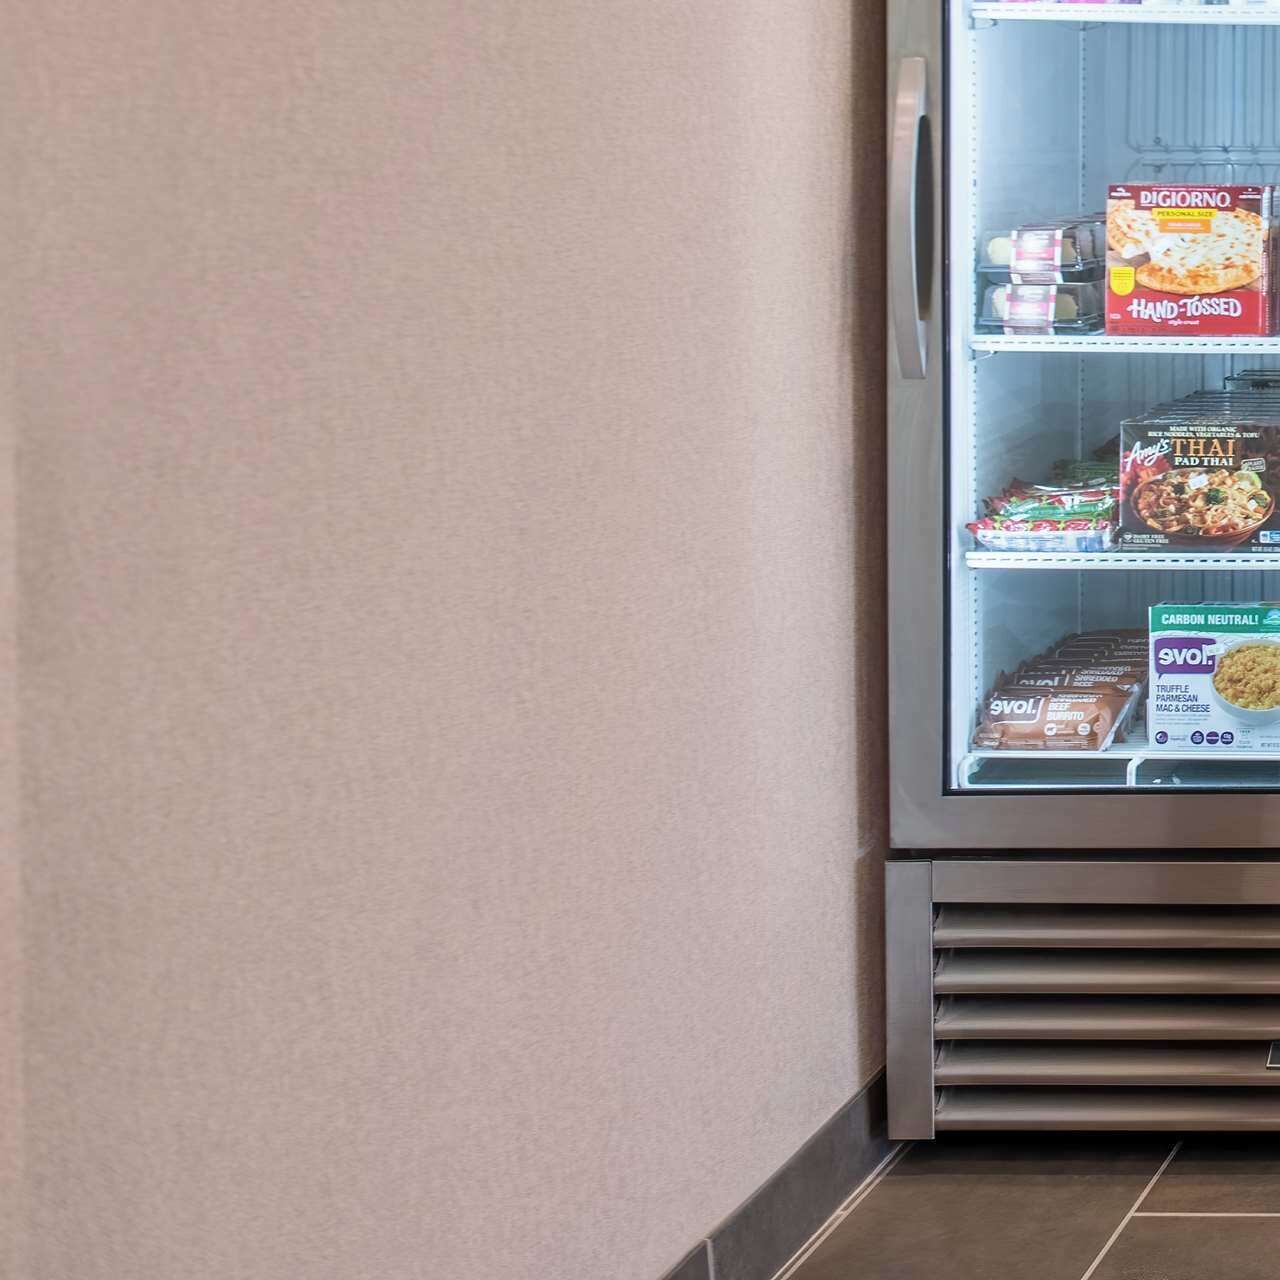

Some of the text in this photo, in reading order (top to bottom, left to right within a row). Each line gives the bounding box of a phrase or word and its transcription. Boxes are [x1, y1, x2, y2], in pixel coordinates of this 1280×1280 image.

[1126, 296, 1241, 323] HAND-TOSSED
[1171, 439, 1235, 456] THAI
[1122, 438, 1172, 471] Amy's
[1174, 457, 1233, 465] PAD THAI
[1162, 614, 1259, 625] CARBON NEUTRAL!
[1156, 685, 1189, 693] TRUFFLE
[1156, 694, 1198, 703] PARMESAN
[1048, 703, 1072, 711] BEEF
[1156, 704, 1210, 712] MAC & CHEESE
[1047, 711, 1085, 720] BURRITO
